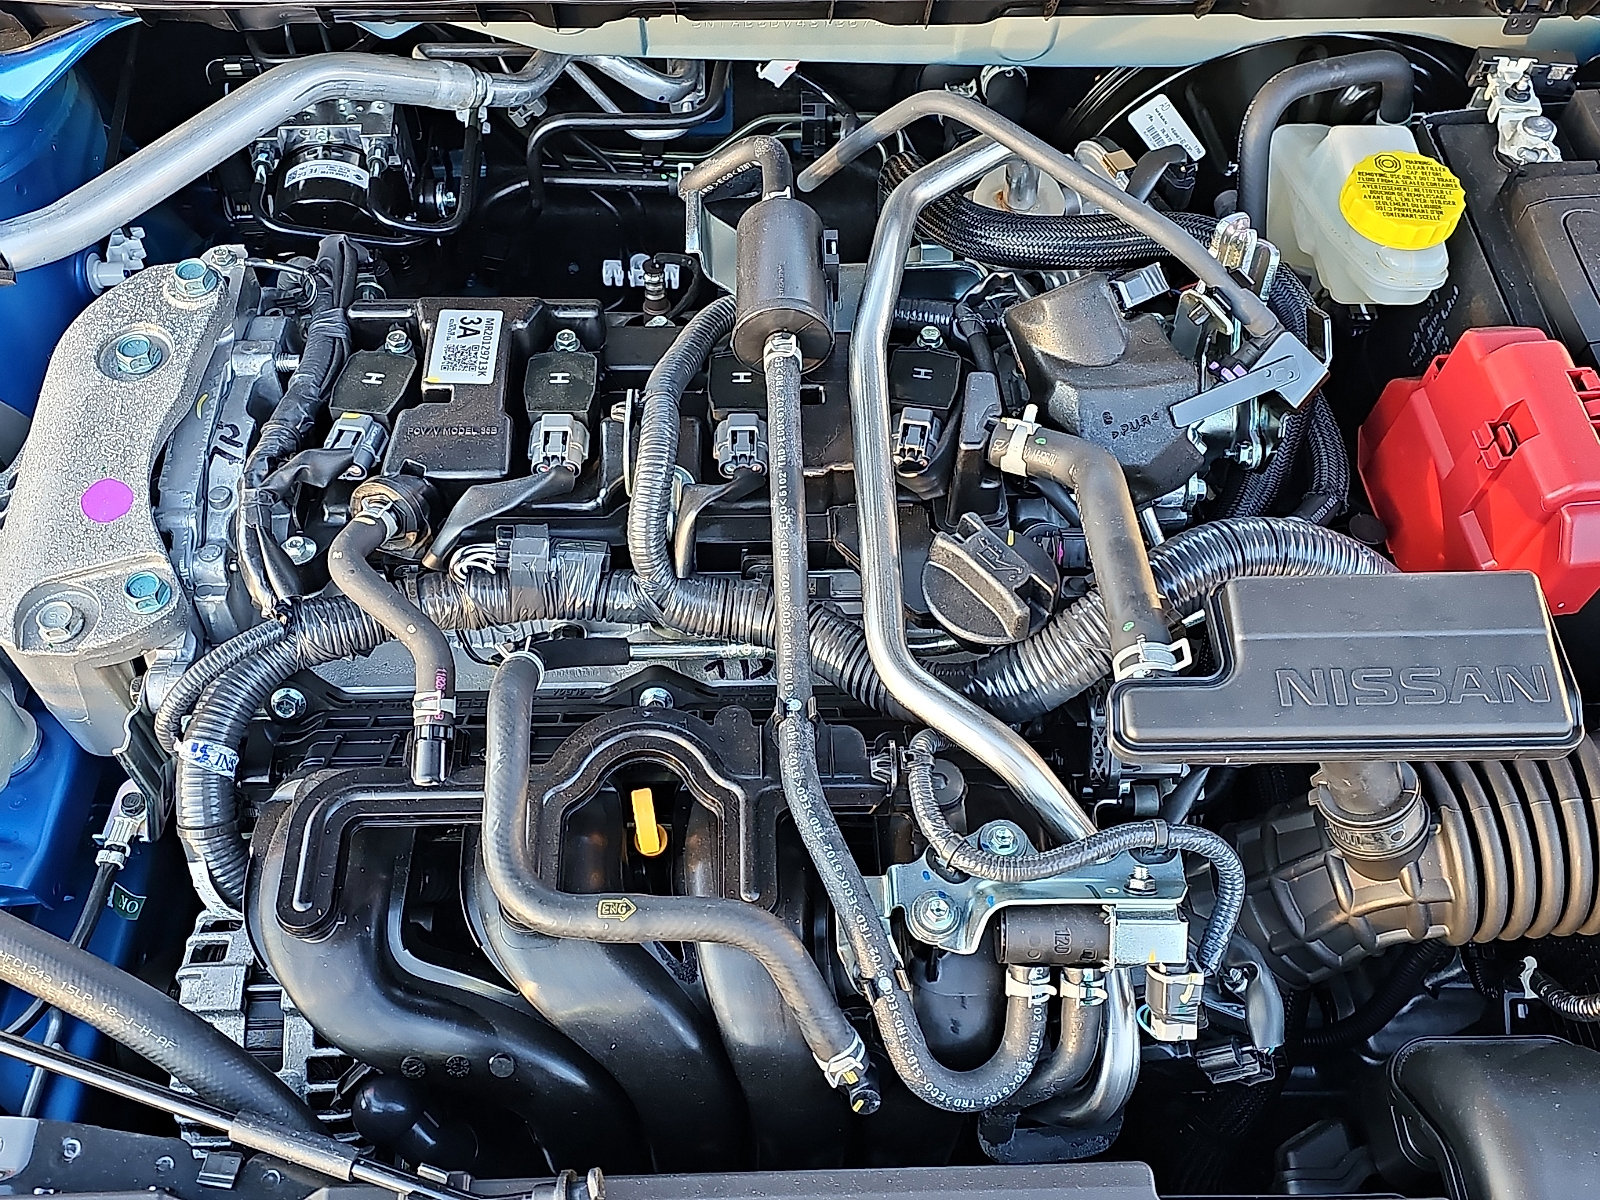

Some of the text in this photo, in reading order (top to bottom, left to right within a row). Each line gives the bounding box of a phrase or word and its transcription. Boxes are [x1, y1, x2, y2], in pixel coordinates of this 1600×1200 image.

[457, 316, 483, 339] 3A
[477, 318, 495, 377] MR20129713K
[549, 372, 571, 384] H
[731, 372, 753, 384] H
[442, 427, 478, 436] MODEL
[1276, 665, 1551, 708] NISSAN
[118, 894, 139, 914] OK
[602, 903, 627, 914] ENG
[1054, 927, 1072, 955] 120
